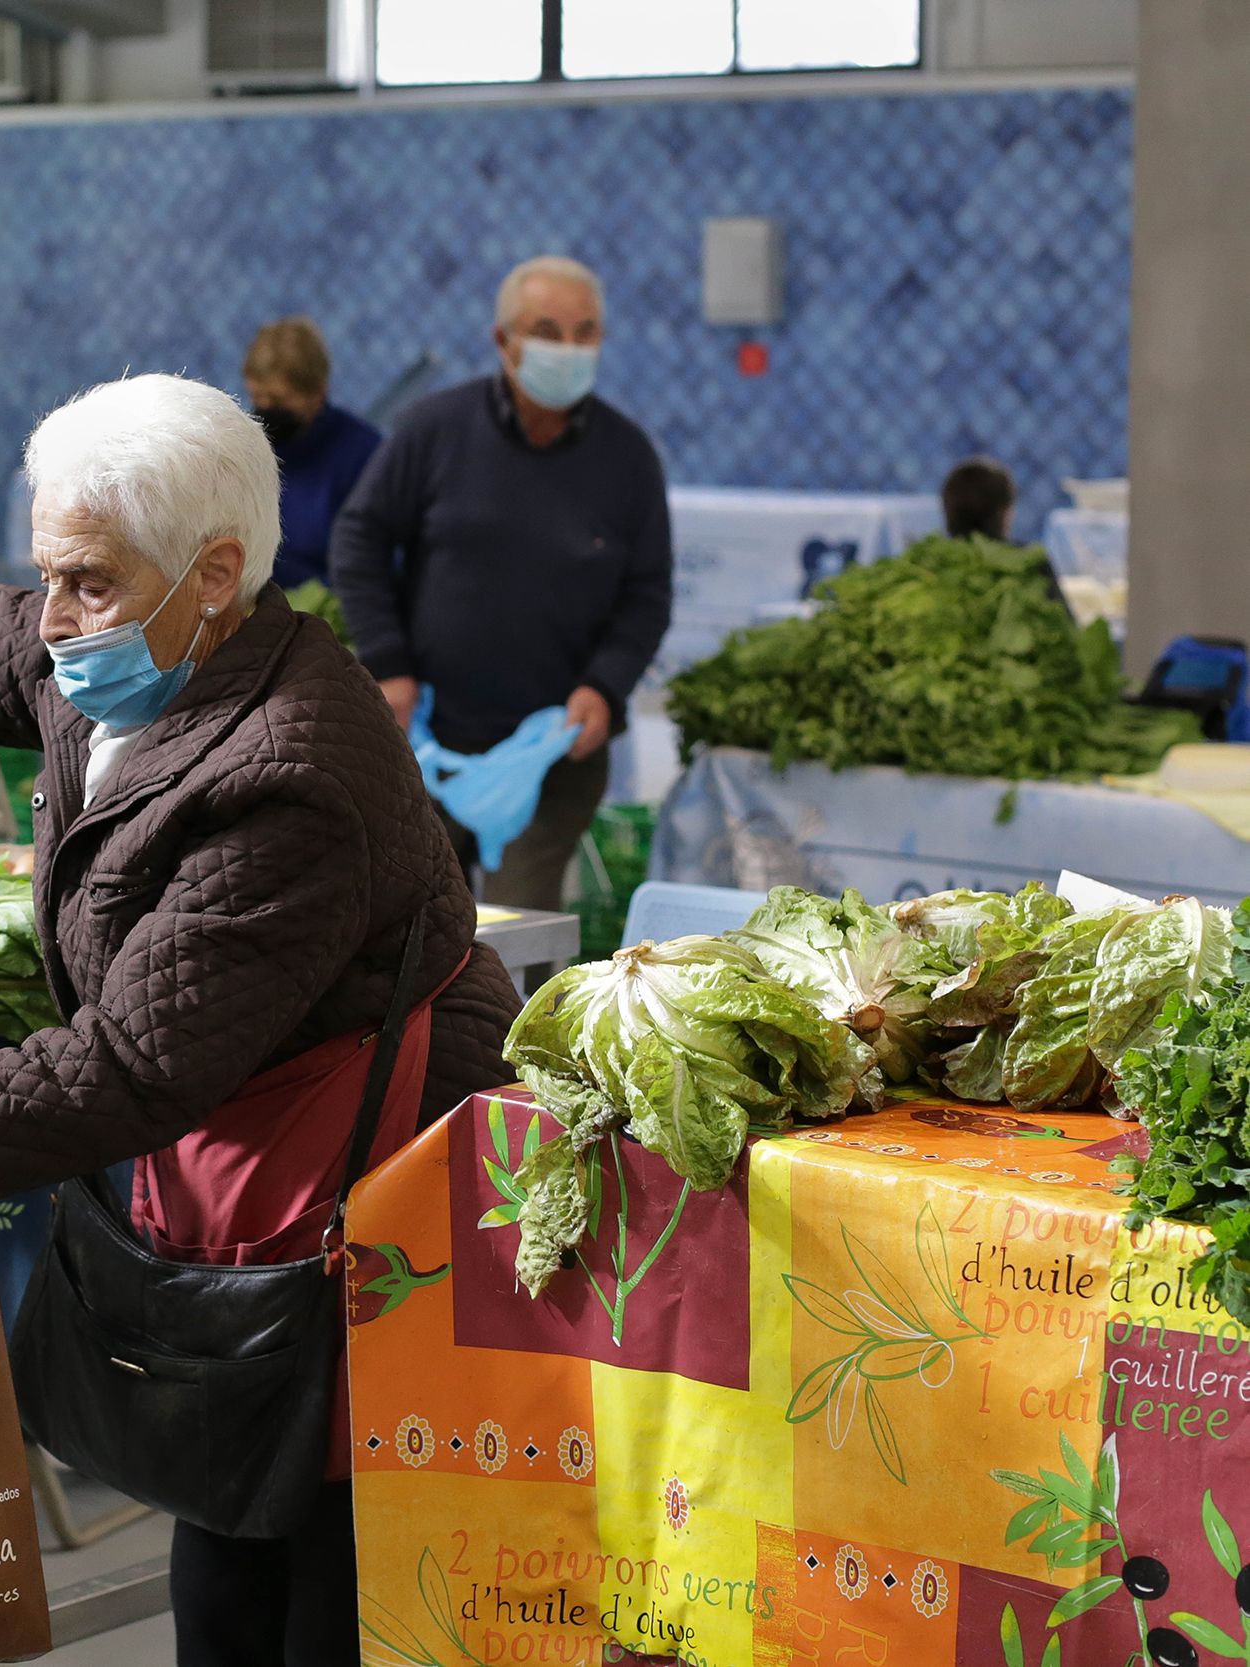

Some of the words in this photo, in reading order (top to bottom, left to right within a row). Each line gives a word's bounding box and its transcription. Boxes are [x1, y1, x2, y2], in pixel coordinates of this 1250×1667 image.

[948, 1185, 980, 1234] 2
[961, 1242, 1095, 1299] d'huile
[1110, 1261, 1222, 1314] d'oliv
[981, 1293, 1170, 1349] poivron
[448, 1529, 472, 1577] 2
[494, 1537, 671, 1596] poivrons
[682, 1571, 777, 1620] verts
[461, 1583, 587, 1627] d'huile
[600, 1593, 698, 1649] d'olive
